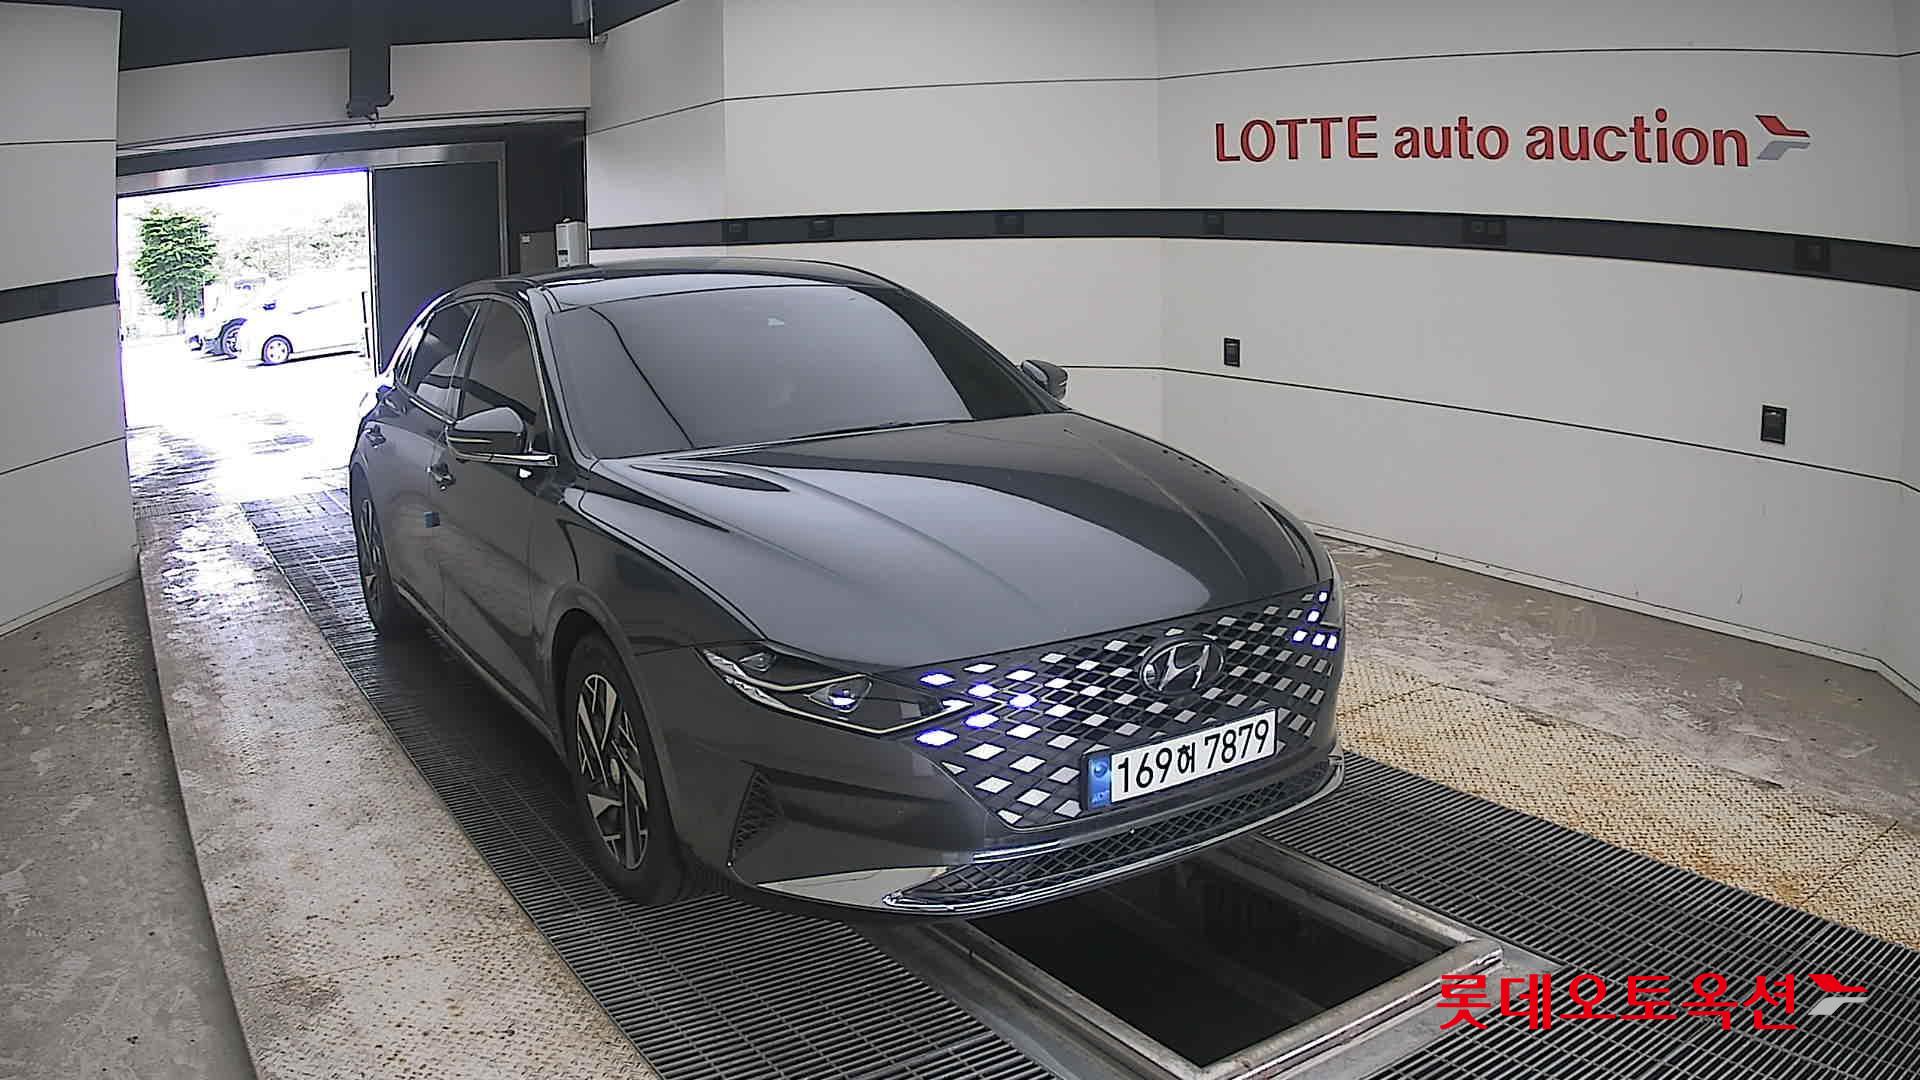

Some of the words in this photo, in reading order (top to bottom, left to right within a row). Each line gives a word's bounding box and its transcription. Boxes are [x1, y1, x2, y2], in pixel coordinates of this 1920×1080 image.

[1215, 115, 1378, 163] LOTTE
[1394, 116, 1510, 161] auto
[1525, 108, 1750, 167] auction
[1117, 742, 1196, 793] 169허
[1204, 719, 1269, 769] 7879
